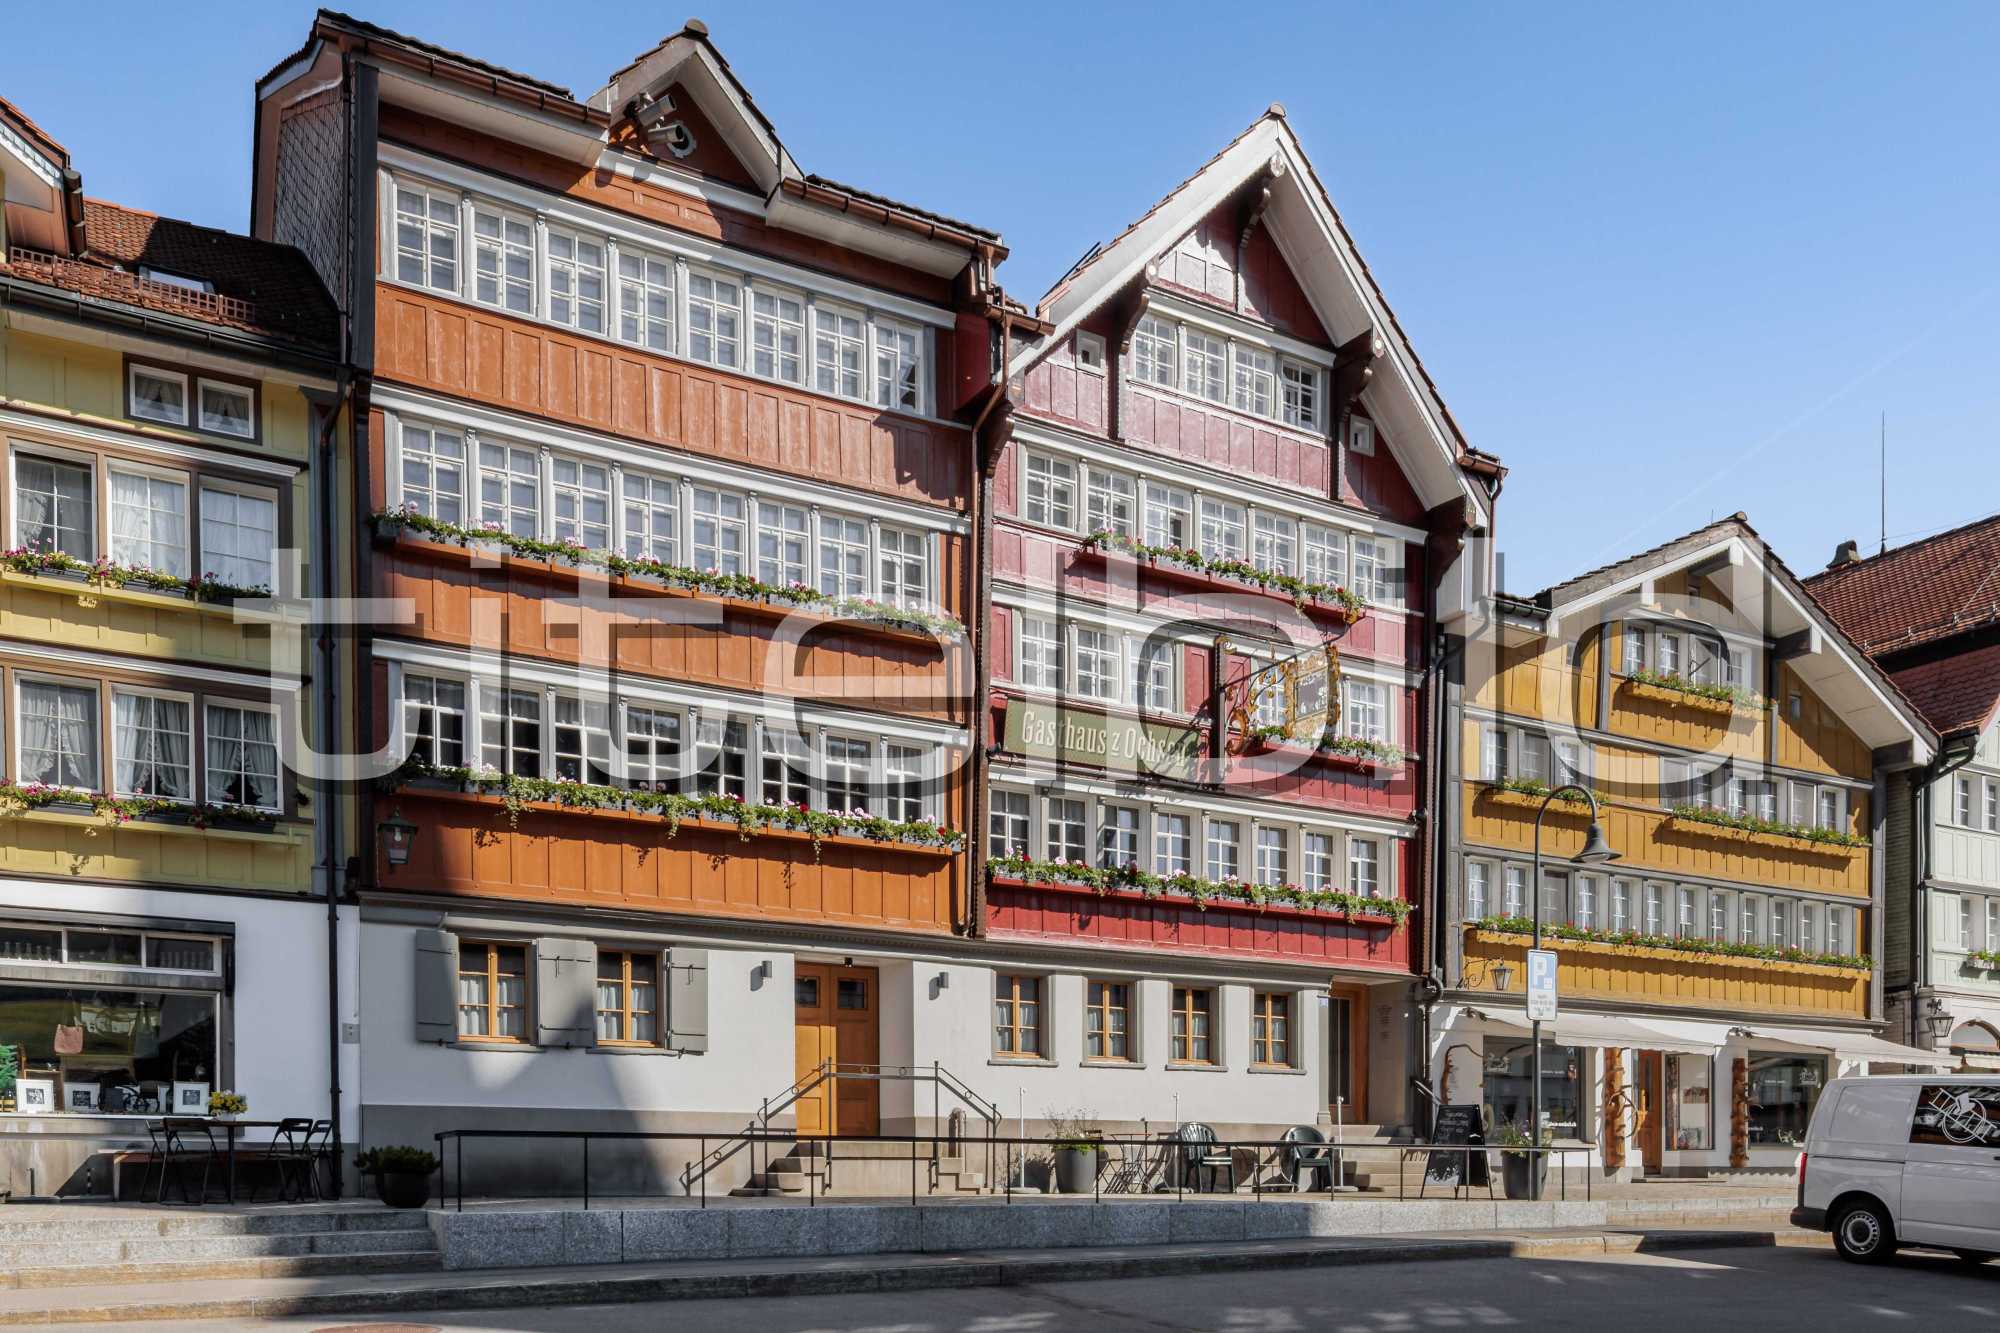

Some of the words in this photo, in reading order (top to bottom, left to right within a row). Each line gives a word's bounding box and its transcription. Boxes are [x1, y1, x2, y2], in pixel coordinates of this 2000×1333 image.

[1022, 710, 1107, 755] Gasthaus
[1124, 727, 1186, 767] Ochsen
[1533, 955, 1548, 991] P
